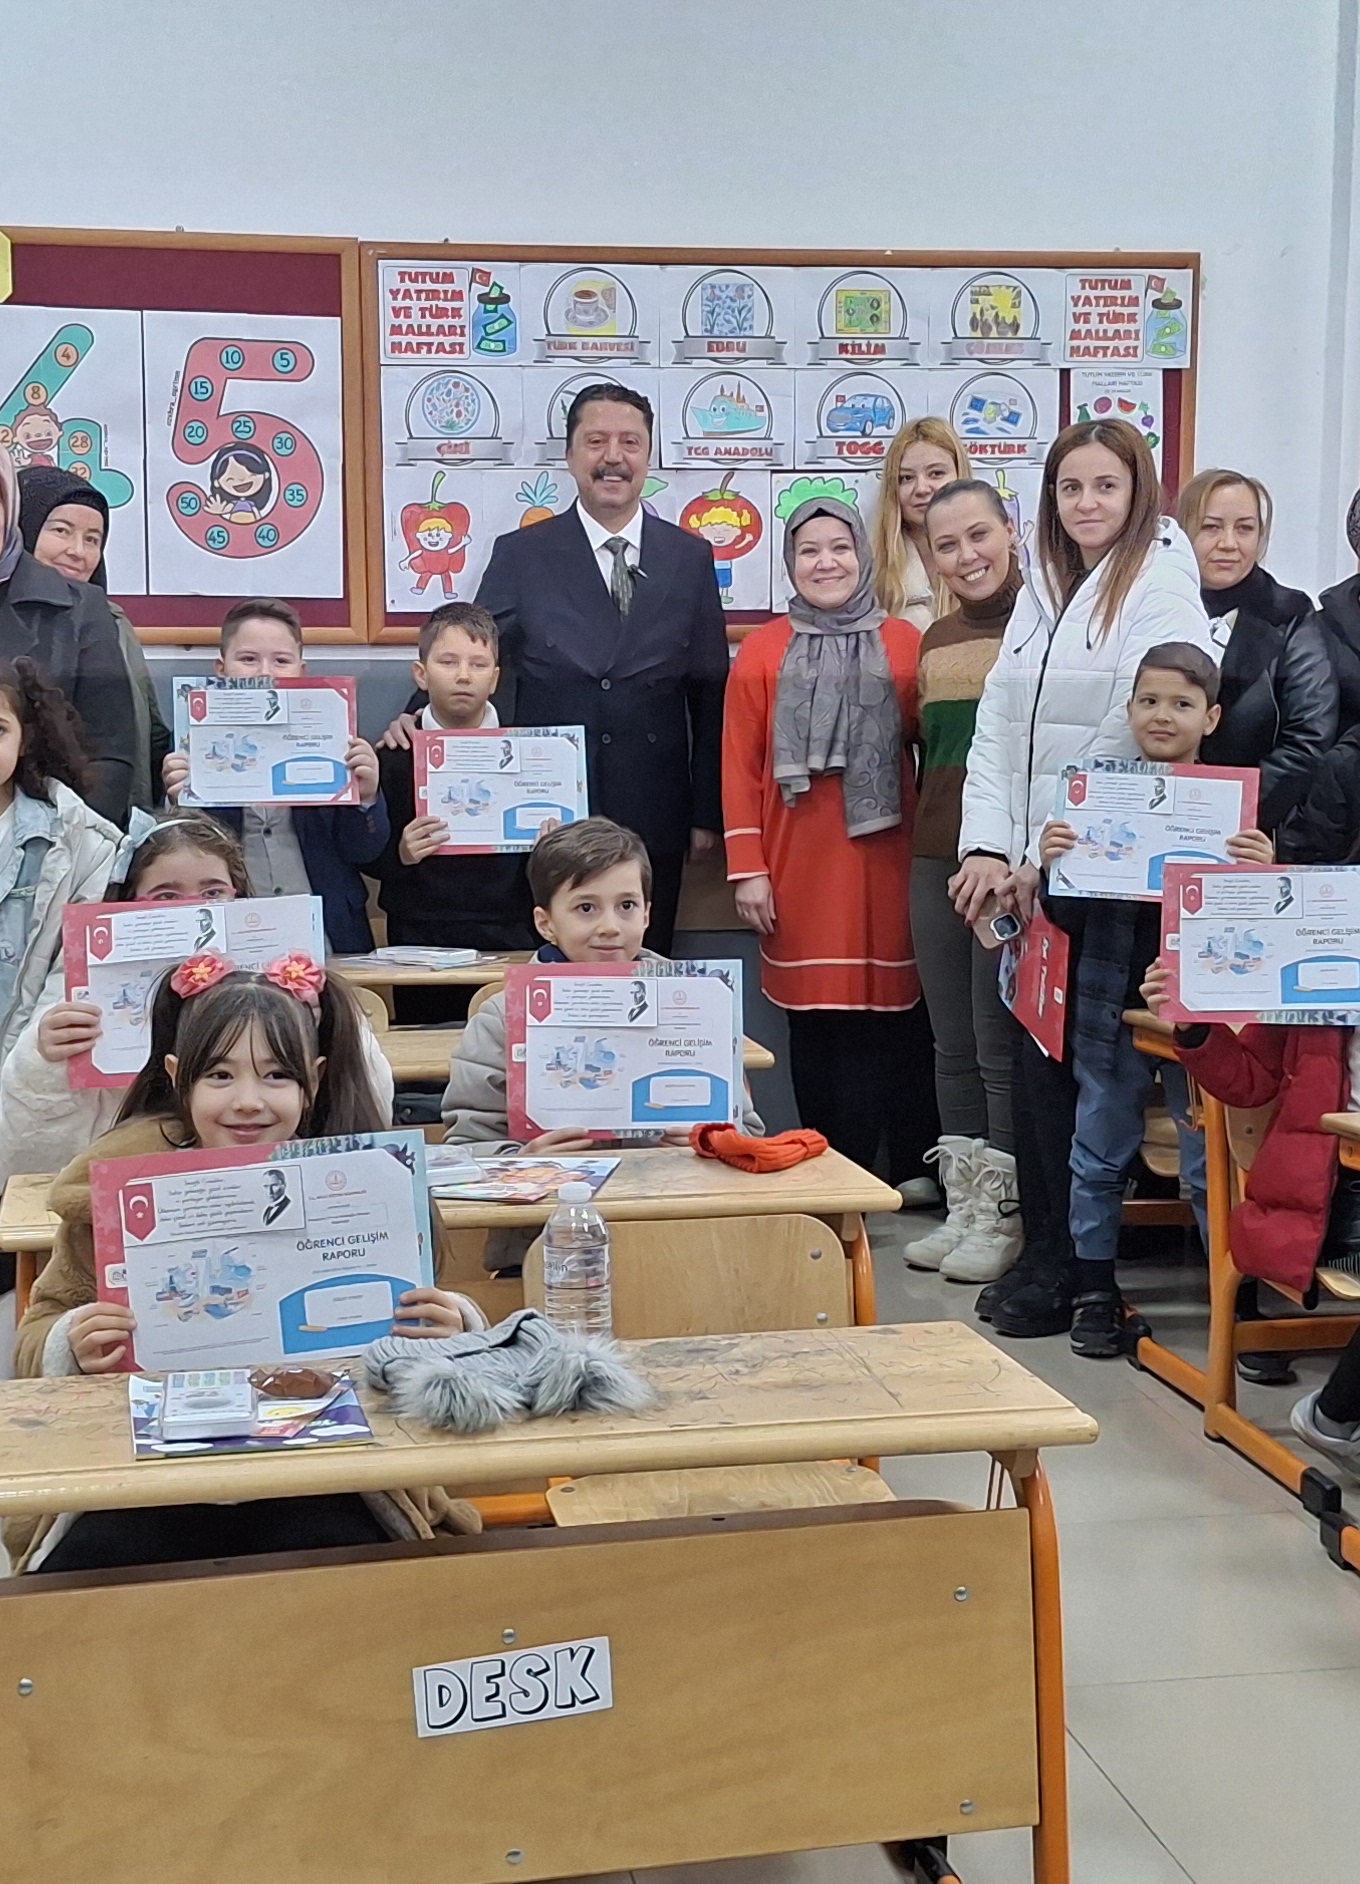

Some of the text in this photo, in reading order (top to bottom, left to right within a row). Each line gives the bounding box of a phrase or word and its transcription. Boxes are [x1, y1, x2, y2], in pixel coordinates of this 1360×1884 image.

[397, 270, 455, 285] TUTUM
[1078, 278, 1133, 291] TUTUM
[388, 288, 465, 303] YATIRIM
[1070, 294, 1140, 308] YATIRIM
[391, 303, 464, 320] VE TÜRK
[1071, 309, 1139, 325] VE TÜRK
[388, 324, 467, 338] MALLARI
[1068, 328, 1141, 342] MALLARI
[390, 341, 466, 355] HAFTASI
[546, 337, 578, 352] TÜRK
[837, 340, 888, 356] KİLİM
[1069, 344, 1140, 358] HAFTASI
[60, 346, 72, 363] 4
[224, 348, 241, 365] 10
[278, 352, 291, 369] 5
[30, 384, 41, 401] 8
[193, 379, 209, 396] 15
[187, 424, 204, 440] 20
[233, 418, 252, 435] 25
[71, 435, 89, 449] 28
[166, 336, 325, 560] 5
[274, 436, 294, 452] 30
[835, 440, 886, 456] TOGG
[687, 445, 774, 458] TCG ANADOLU
[286, 487, 306, 503] 35
[180, 496, 198, 512] 50
[207, 529, 228, 545] 45
[257, 527, 277, 543] 40
[296, 1229, 390, 1252] ÖĞRENCİ GELİŞİM
[322, 1247, 366, 1262] RAPORU
[423, 1645, 601, 1730] DESK
